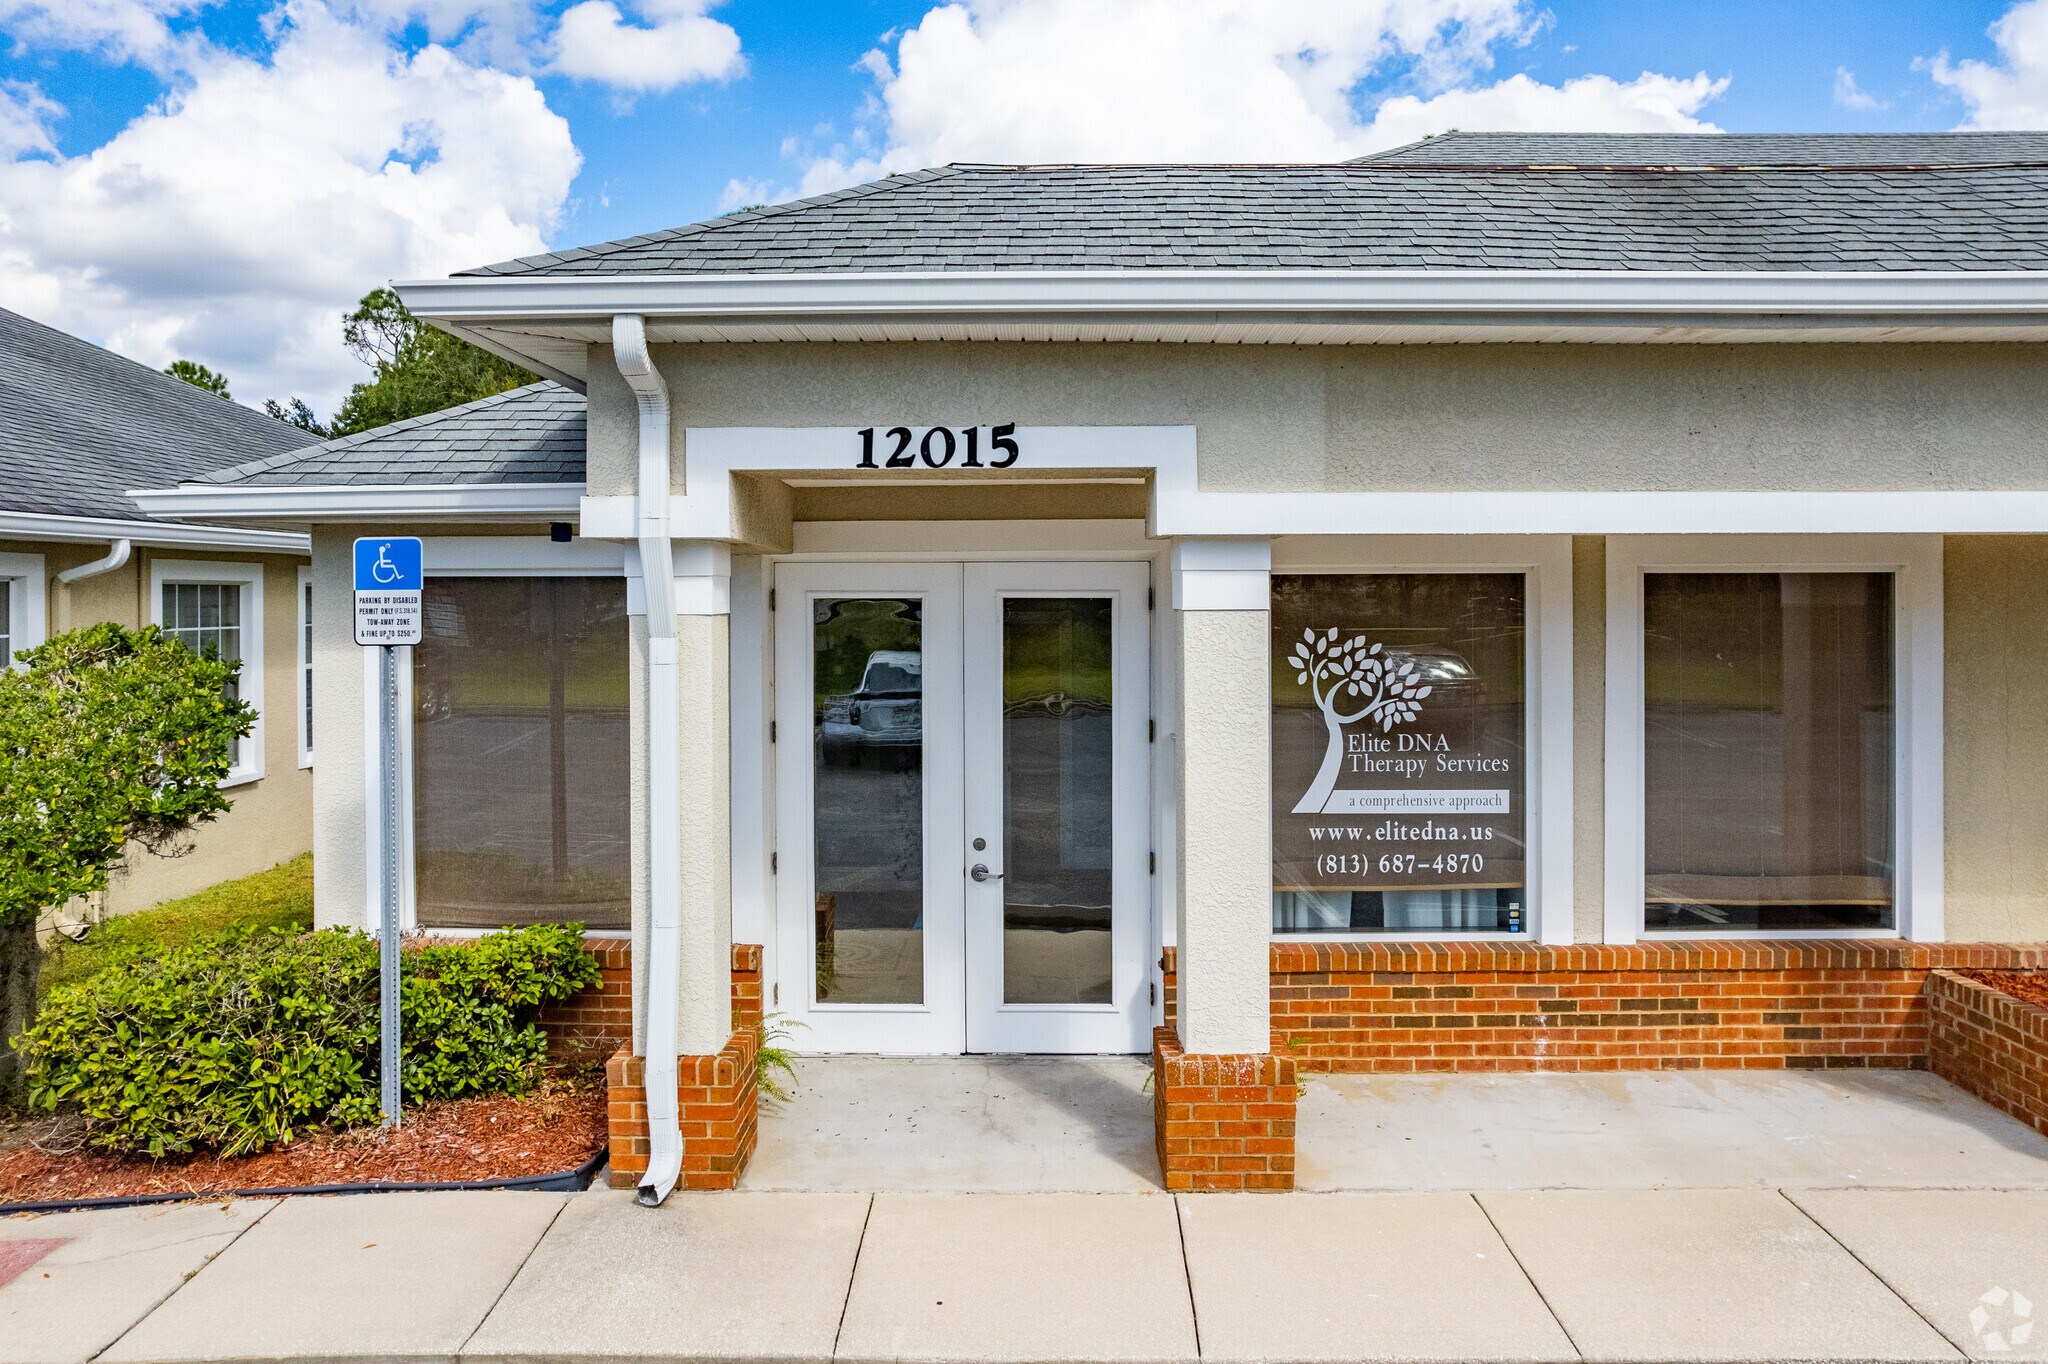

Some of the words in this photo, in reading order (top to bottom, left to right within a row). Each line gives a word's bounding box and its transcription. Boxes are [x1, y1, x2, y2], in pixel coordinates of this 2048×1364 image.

[856, 422, 1019, 469] 12015
[1347, 733, 1391, 753] Elite
[1397, 733, 1451, 752] DNA
[1348, 753, 1428, 778] Therapy
[1436, 753, 1509, 772] Services
[1349, 795, 1356, 807] a
[1359, 793, 1445, 811] comprehensive
[1449, 793, 1502, 811] approach
[1309, 821, 1493, 841] www.elitedna.us
[1316, 853, 1369, 877] (813)
[1379, 853, 1484, 874] 687-4870
